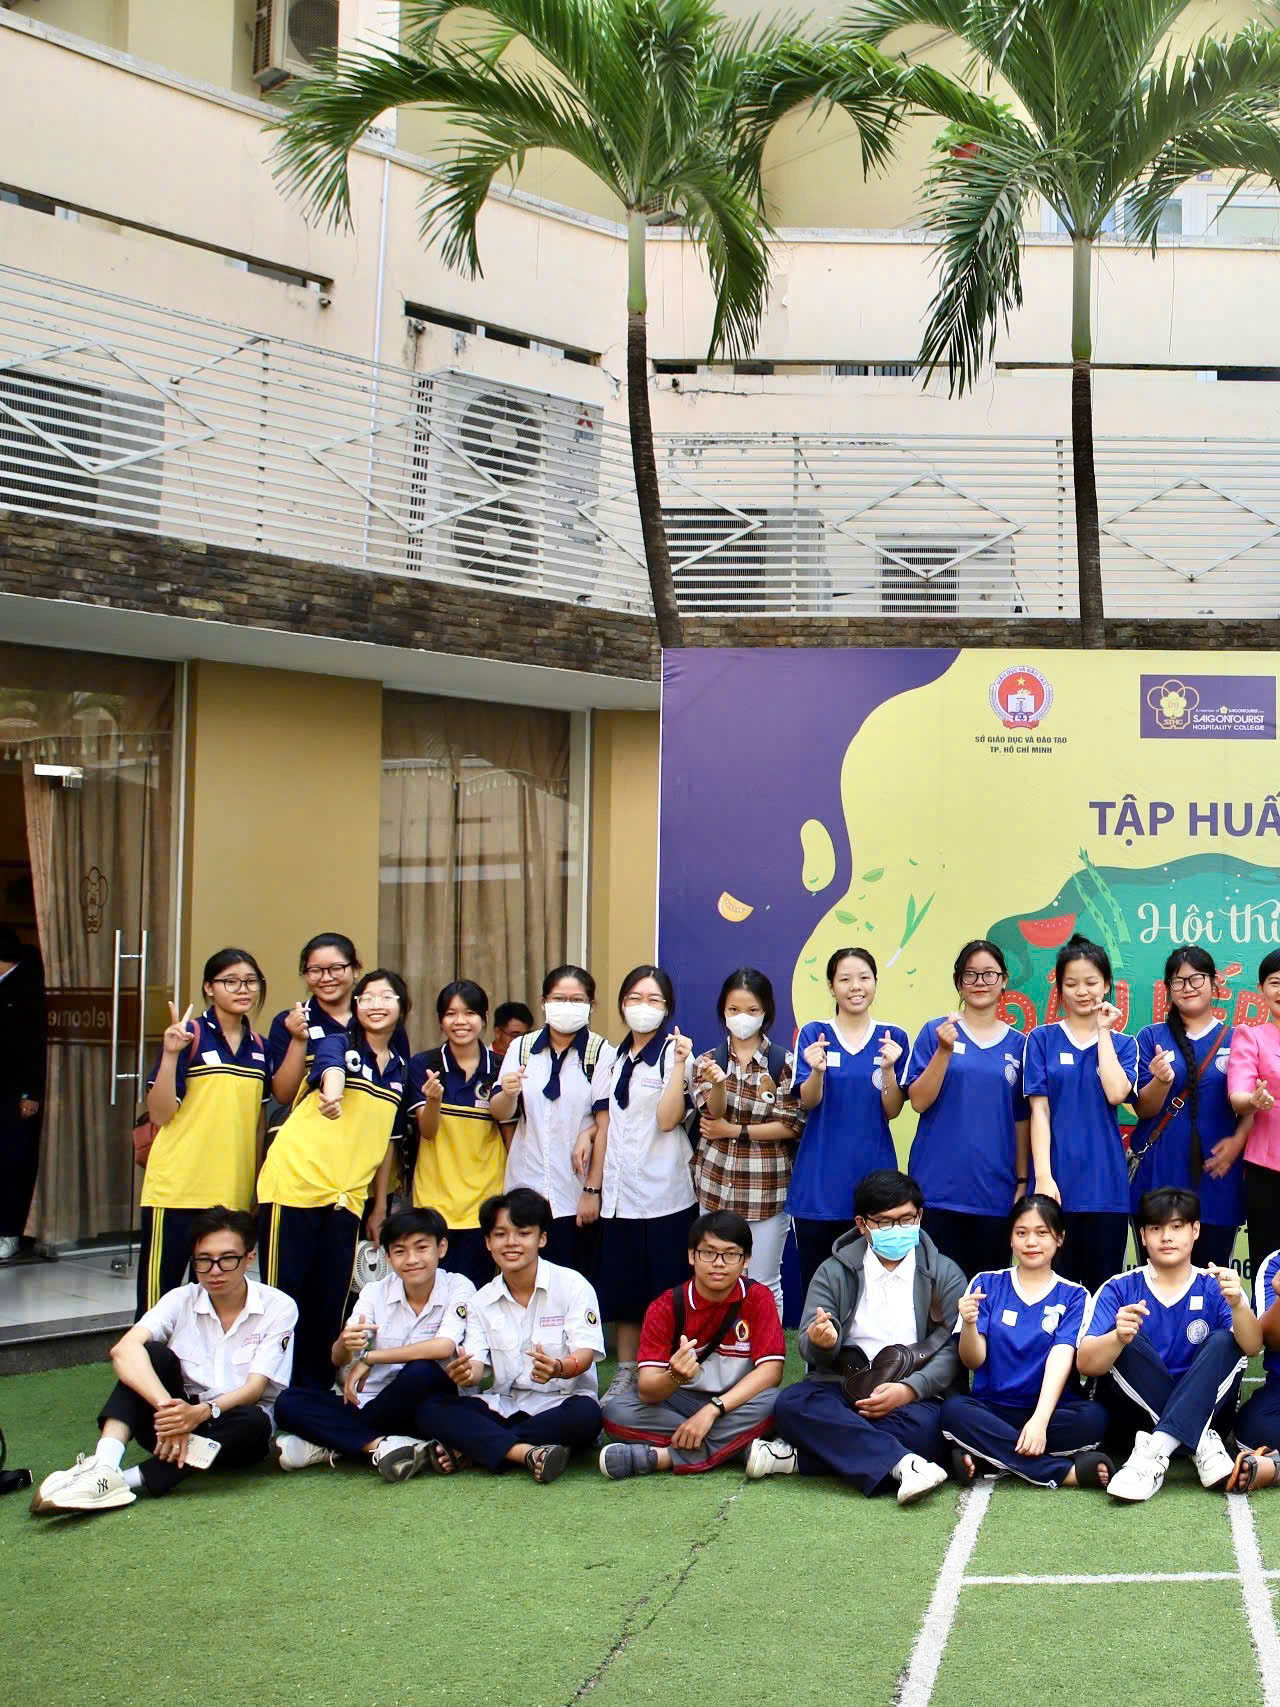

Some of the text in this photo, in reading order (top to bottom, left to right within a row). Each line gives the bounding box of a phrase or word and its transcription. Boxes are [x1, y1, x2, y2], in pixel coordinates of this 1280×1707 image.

[1192, 714, 1265, 724] SAIGONTOURIST
[987, 735, 1006, 743] GIÁO
[1024, 735, 1035, 743] VÀ
[990, 746, 1002, 754] TP.
[1016, 745, 1030, 753] CHÍ
[1031, 746, 1053, 754] MINH
[1088, 793, 1175, 847] TẬP
[1137, 902, 1222, 948] Hội
